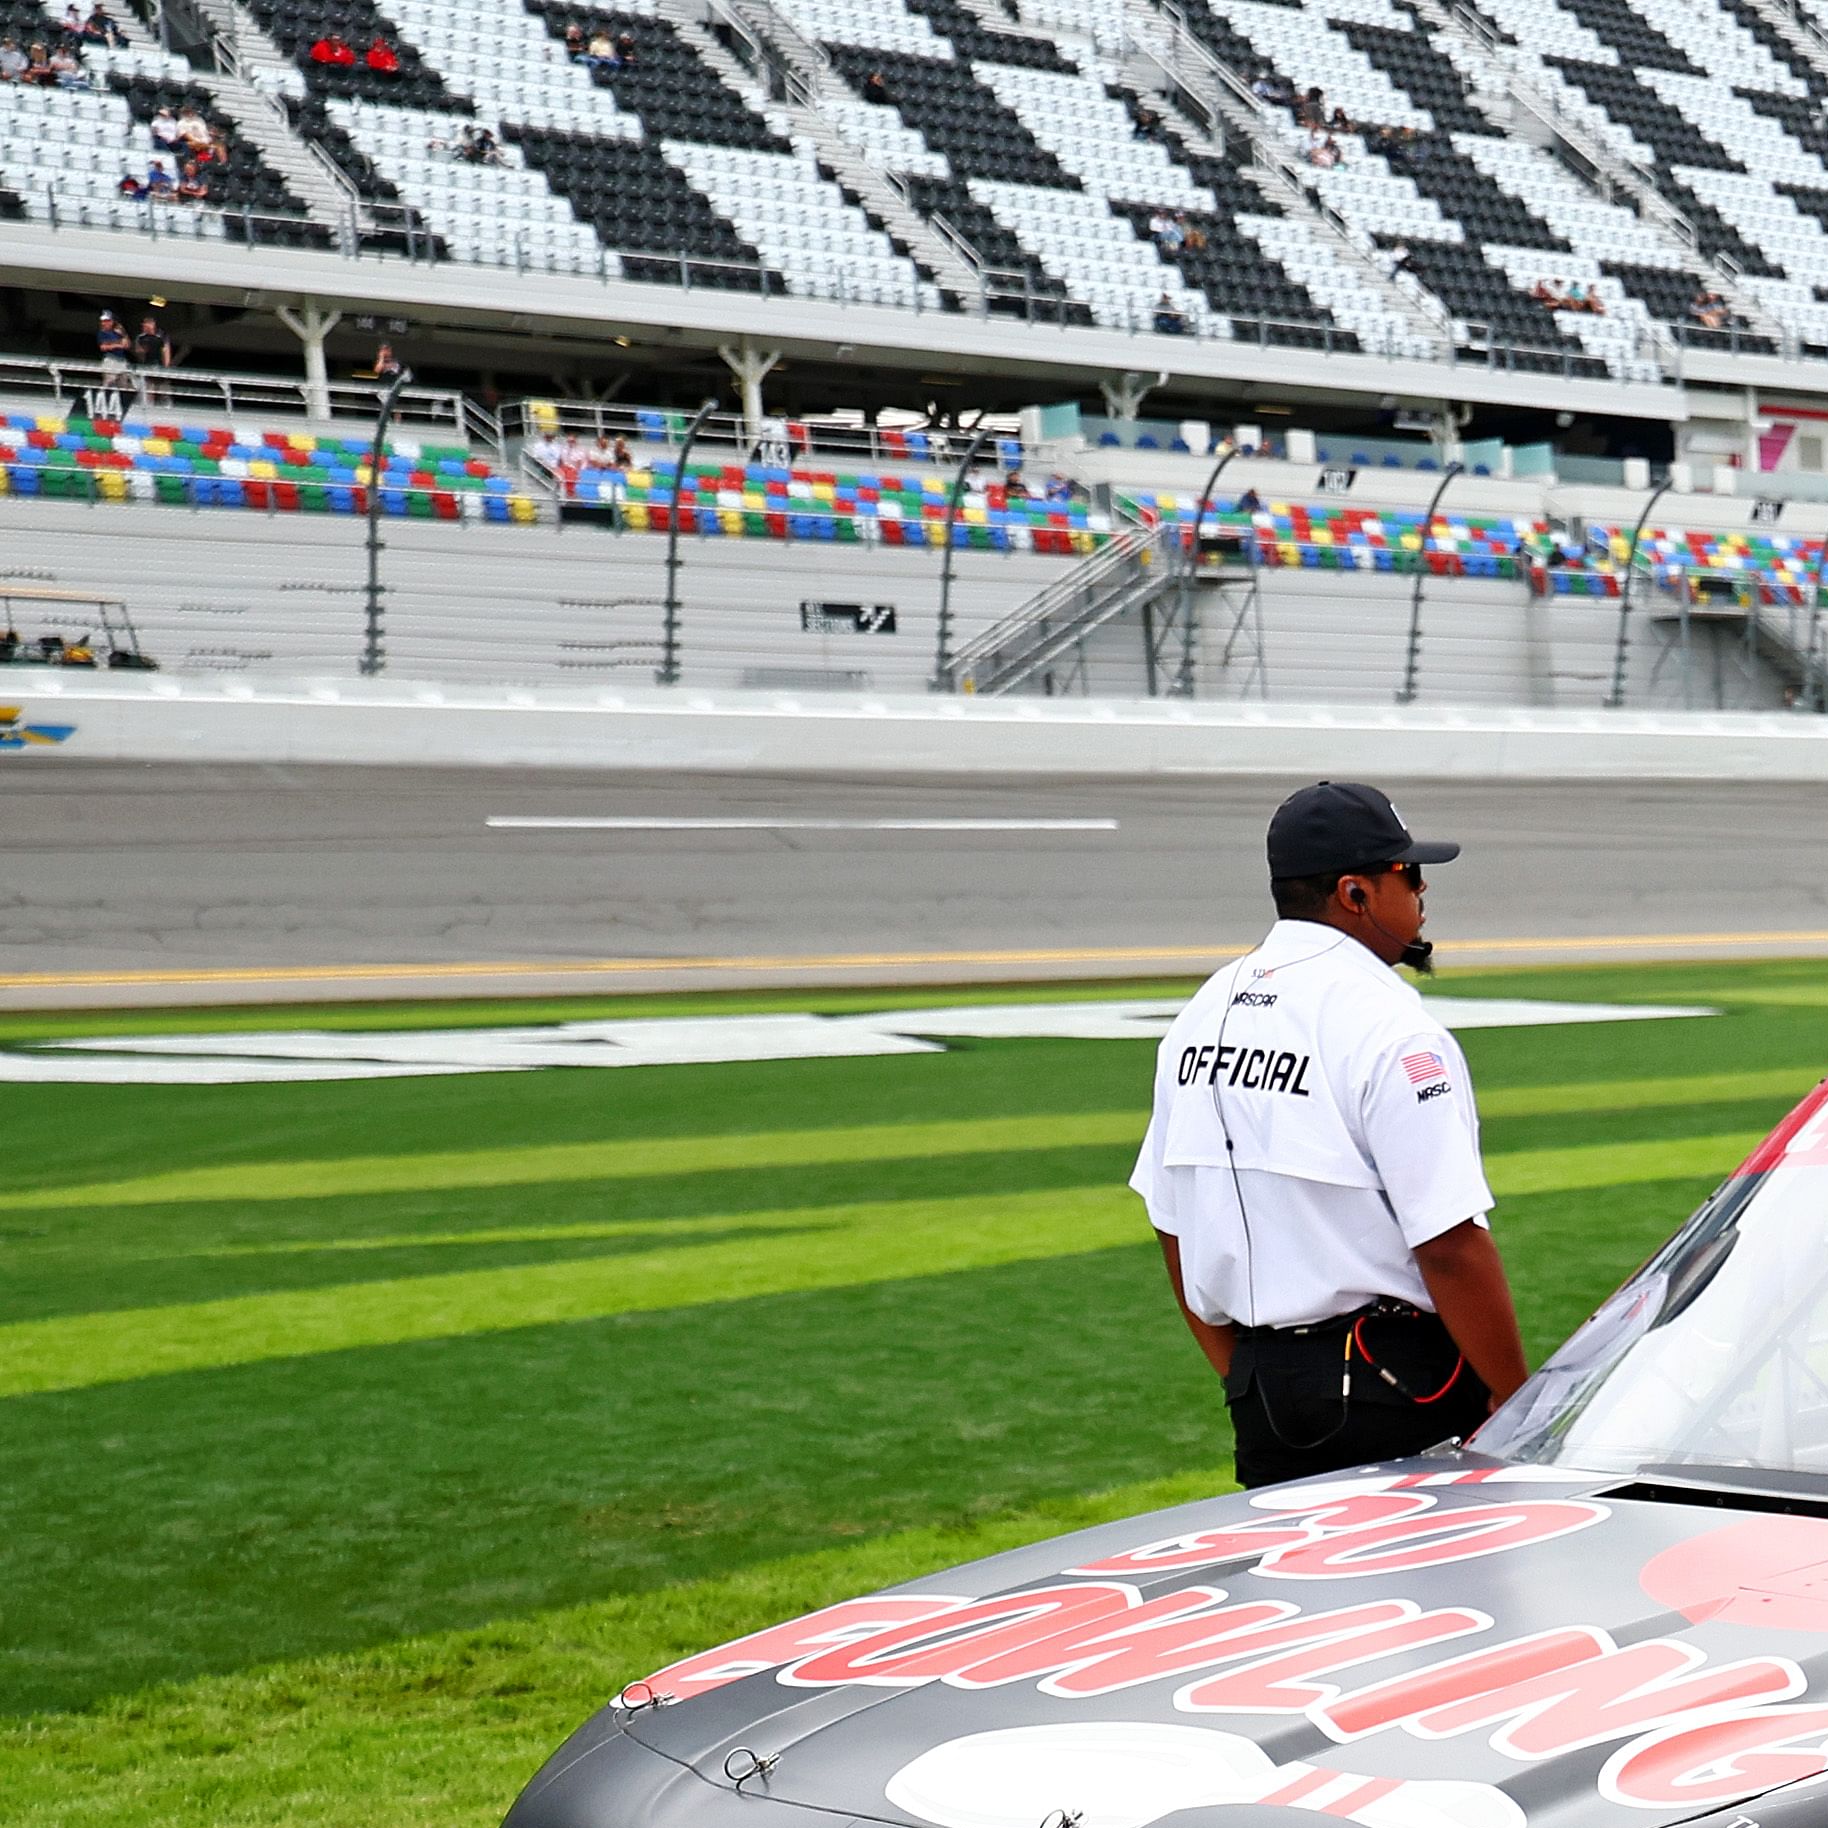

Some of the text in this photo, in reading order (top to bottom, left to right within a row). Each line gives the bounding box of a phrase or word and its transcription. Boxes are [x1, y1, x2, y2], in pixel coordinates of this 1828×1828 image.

[1178, 1045, 1311, 1097] OFFICIAL
[1418, 1082, 1452, 1104] NASC
[1075, 1490, 1613, 1581] GO
